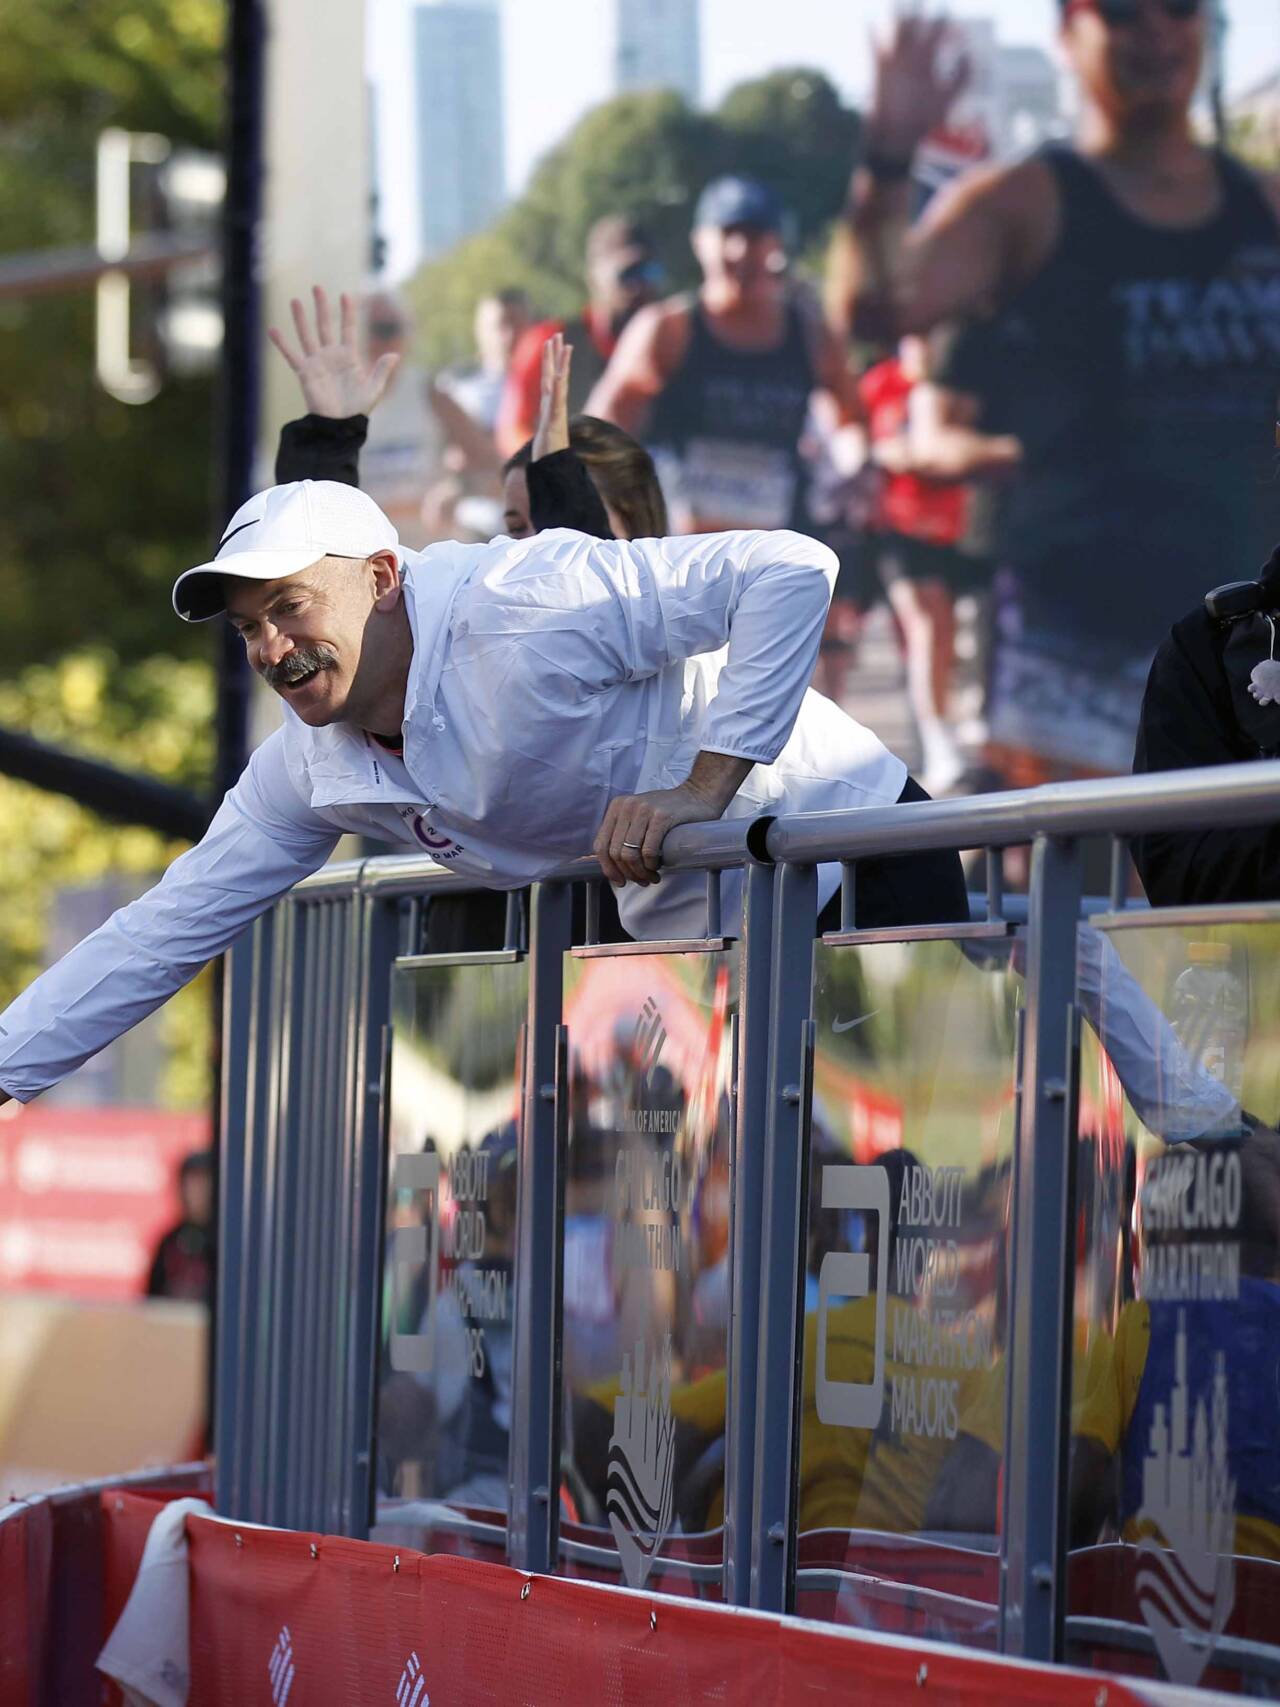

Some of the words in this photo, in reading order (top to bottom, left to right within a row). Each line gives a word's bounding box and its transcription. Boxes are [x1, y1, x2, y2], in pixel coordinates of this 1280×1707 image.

[637, 1110, 648, 1132] OF
[897, 1165, 965, 1228] ABBOTT
[896, 1237, 959, 1297] WORLD
[892, 1307, 994, 1371] MARATHON
[891, 1376, 959, 1440] MAJORS
